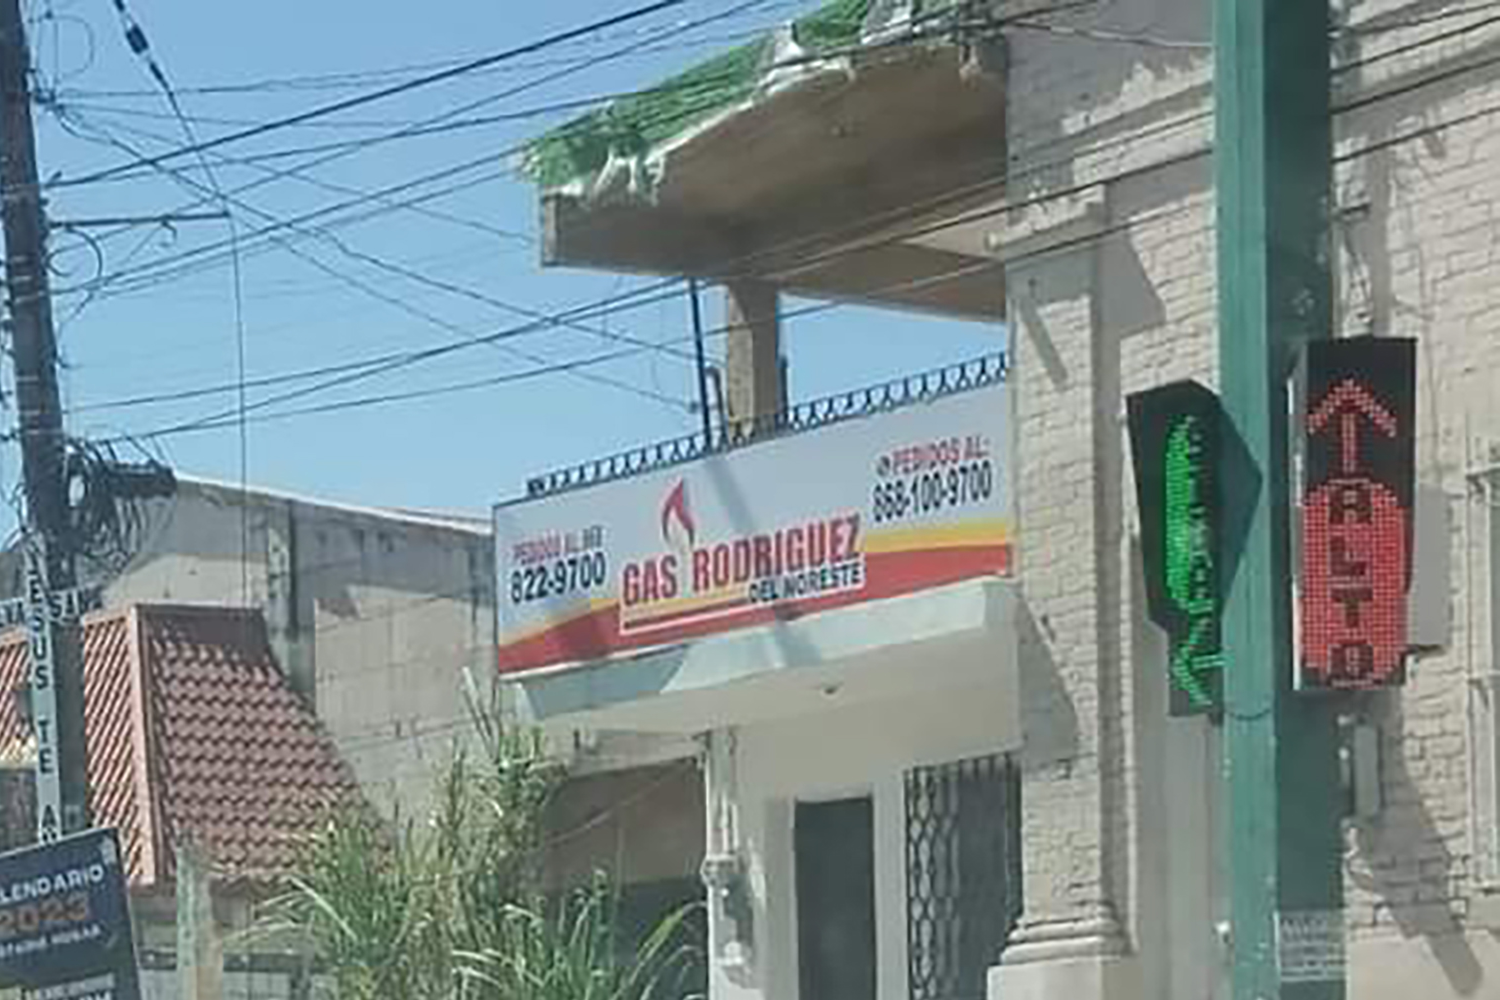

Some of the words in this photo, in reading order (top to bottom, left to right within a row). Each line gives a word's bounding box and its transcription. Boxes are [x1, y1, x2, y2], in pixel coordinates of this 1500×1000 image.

[873, 459, 992, 522] 868-100-9700
[511, 550, 606, 605] 822-9700
[622, 554, 678, 606] GAS
[692, 513, 862, 592] RODRIGUEZ
[750, 576, 779, 604] DEL
[784, 561, 861, 597] NORESTE
[1328, 484, 1375, 684] ALTO
[38, 718, 53, 774] TE
